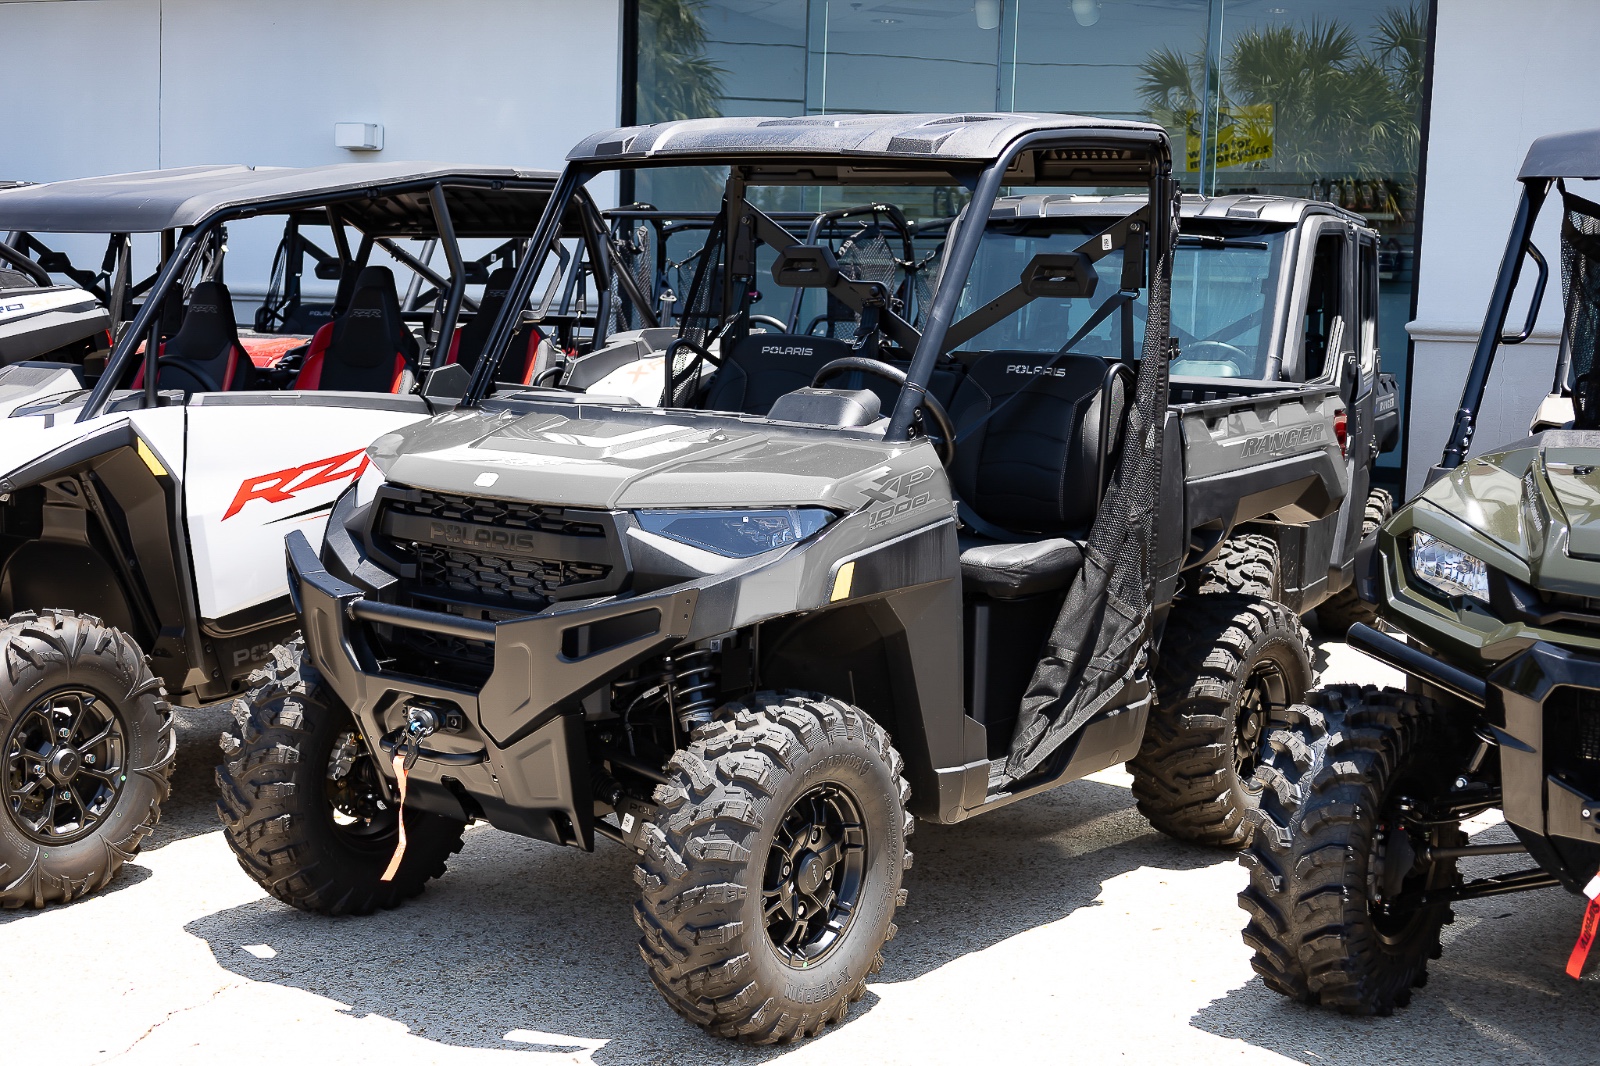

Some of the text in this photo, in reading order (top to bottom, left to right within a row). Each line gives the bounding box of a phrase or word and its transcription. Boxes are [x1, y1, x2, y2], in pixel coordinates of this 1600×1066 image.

[1231, 138, 1251, 149] for
[189, 304, 218, 313] RZR
[350, 308, 382, 318] RZR
[761, 346, 814, 356] POLARIS
[1006, 364, 1067, 377] POLARIS
[1240, 423, 1325, 459] RANGER
[854, 465, 935, 514] XP
[869, 491, 930, 526] 1000
[430, 521, 535, 553] POLARIS
